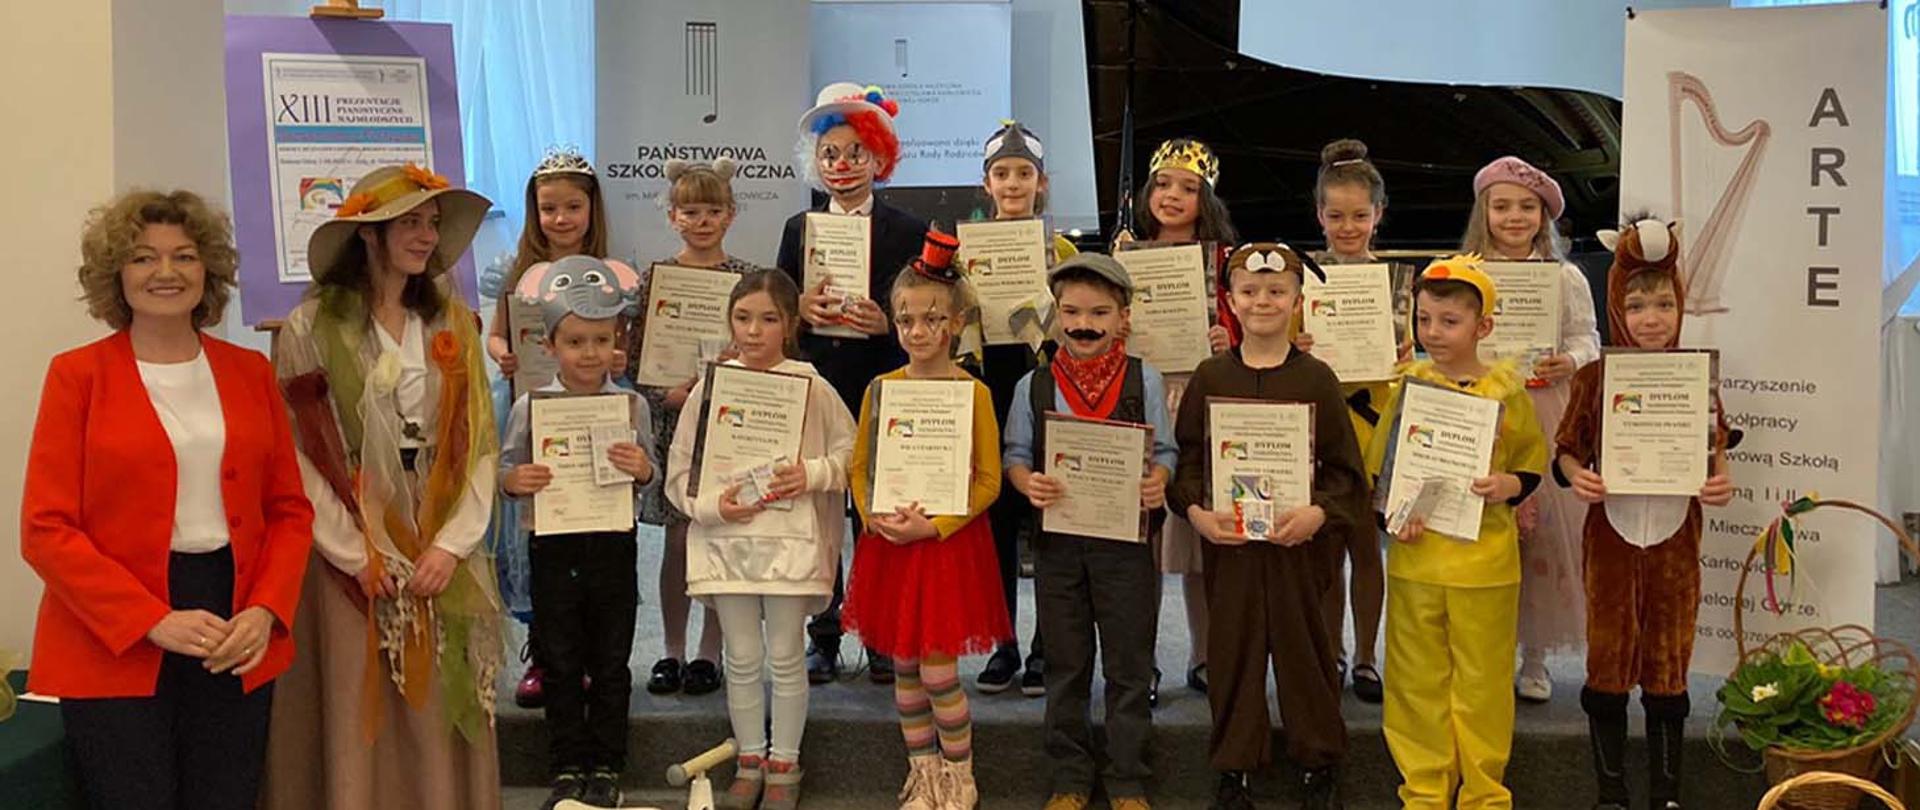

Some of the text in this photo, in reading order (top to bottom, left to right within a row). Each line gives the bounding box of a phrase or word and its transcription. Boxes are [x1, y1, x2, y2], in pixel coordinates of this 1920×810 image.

[277, 93, 331, 123] XIII
[336, 97, 400, 105] PREZENTACJE
[638, 143, 767, 160] PAŃSTWOWA
[1807, 87, 1850, 307] ARTE
[1156, 282, 1190, 290] DYPLOM
[1720, 377, 1817, 394] arzyszenie
[1649, 392, 1690, 400] DYPLOM
[920, 418, 956, 426] DYPLOM
[1441, 430, 1476, 444] DYPLOM
[1088, 455, 1126, 465] DYPLOM
[1724, 451, 1774, 468] wową
